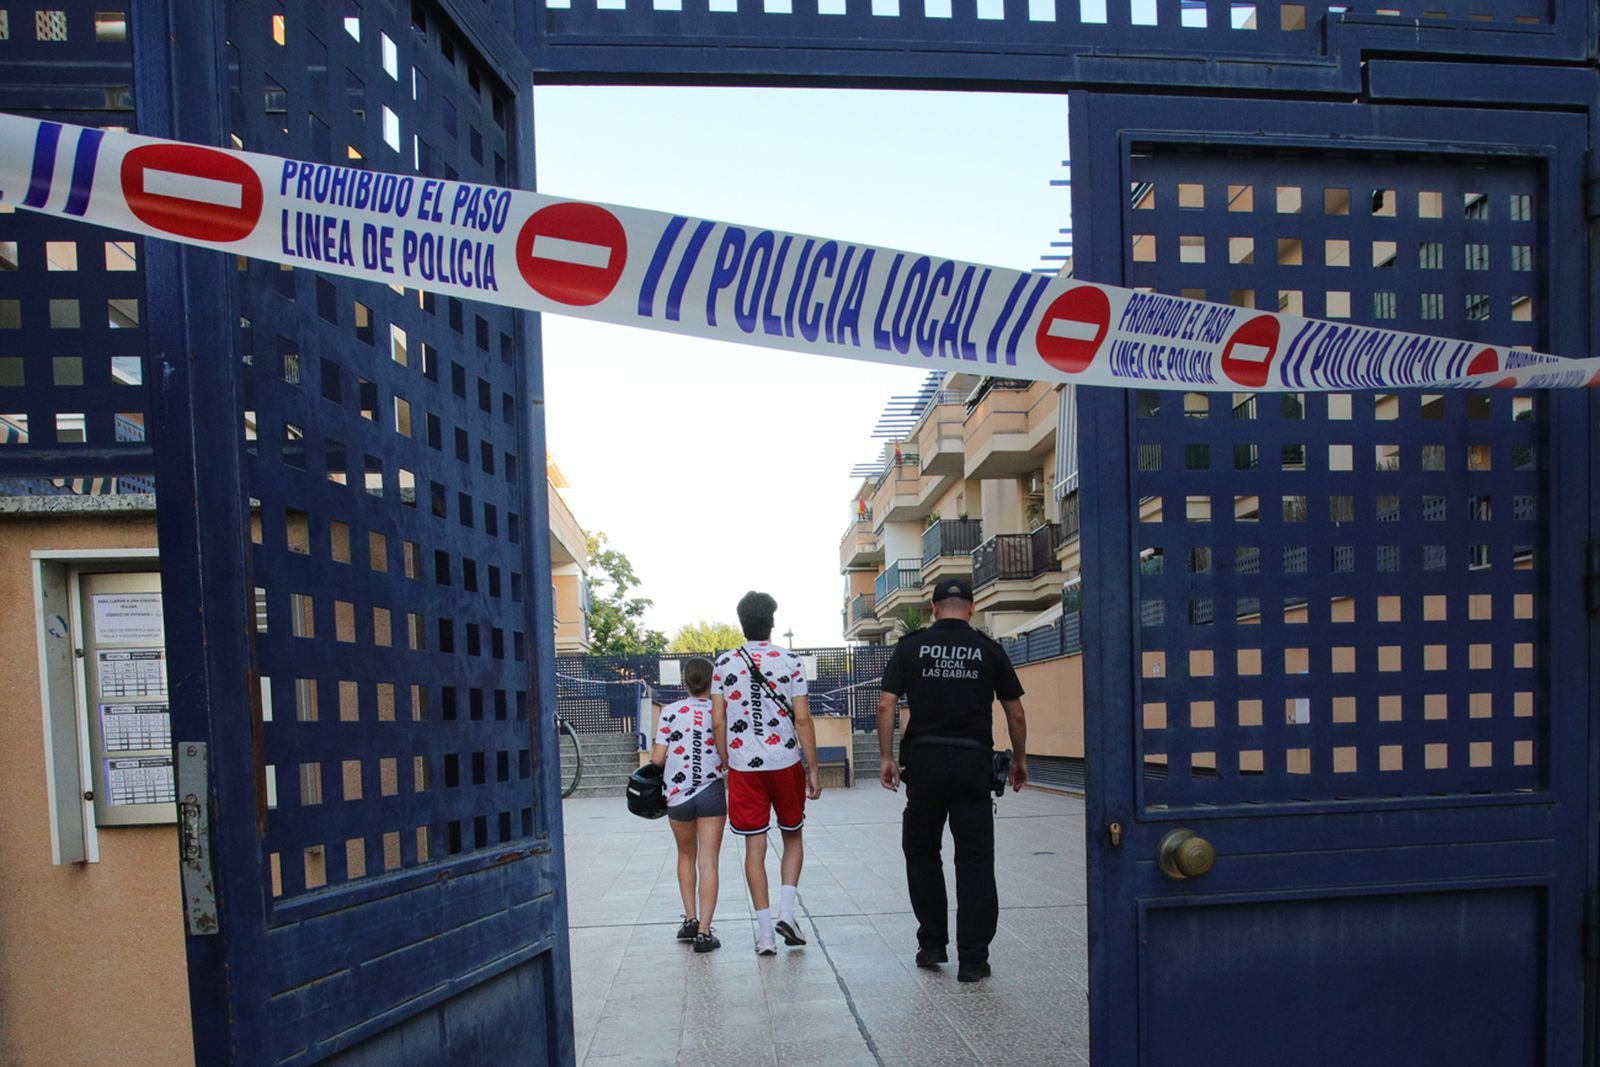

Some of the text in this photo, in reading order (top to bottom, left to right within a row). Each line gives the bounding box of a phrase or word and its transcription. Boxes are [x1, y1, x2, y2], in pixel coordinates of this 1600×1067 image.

[280, 159, 512, 234] PROHIBIDO EL PASO
[281, 209, 498, 292] LINEA DE POLICIA
[706, 226, 993, 361] POLICIA LOCAL
[1118, 292, 1236, 344] PROHIBIDO EL PASO
[1109, 339, 1218, 385] LINEA DE POLICIA
[919, 645, 982, 661] POLICIA
[922, 668, 979, 679] LAS GABIAS
[935, 660, 966, 669] LOCAL
[693, 710, 703, 727] SIX
[692, 729, 703, 787] MORRIGAN
